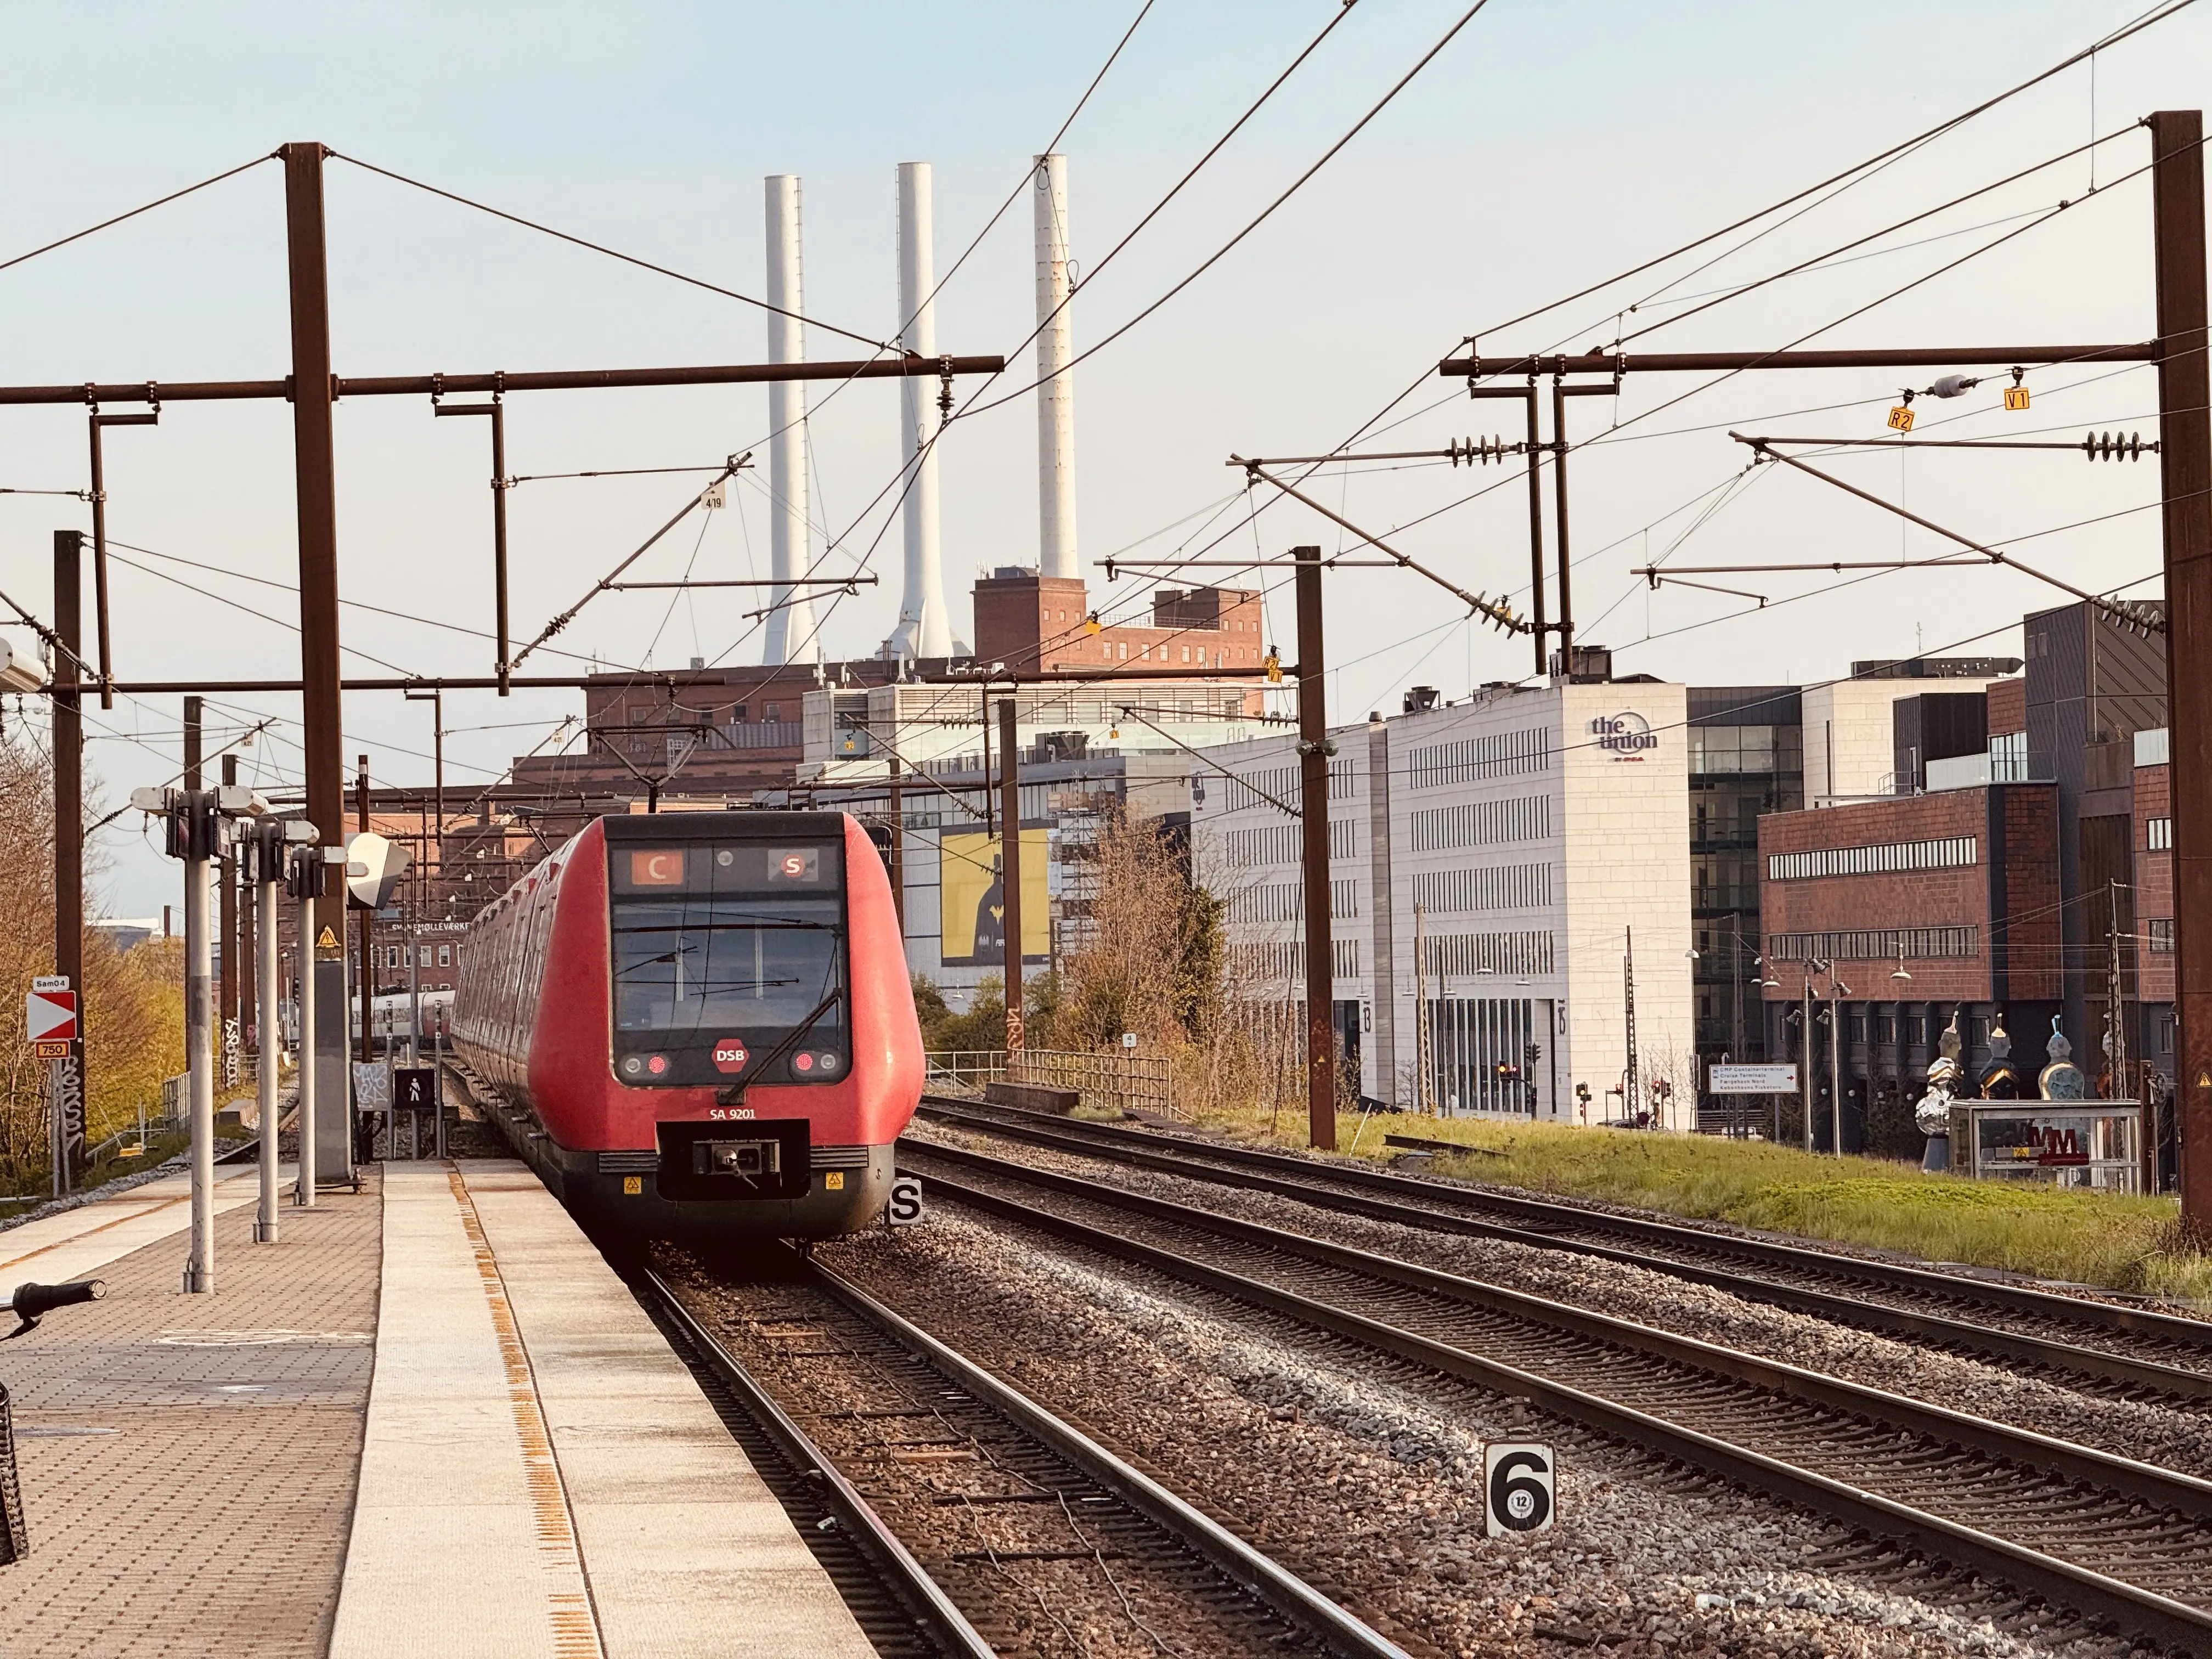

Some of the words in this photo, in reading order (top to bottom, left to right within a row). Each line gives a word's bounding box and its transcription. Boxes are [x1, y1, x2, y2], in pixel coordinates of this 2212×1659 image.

[1891, 411, 1910, 429] R2
[706, 498, 721, 508] 4/19
[1592, 716, 1625, 734] the
[1600, 730, 1658, 749] union
[648, 856, 667, 879] C
[786, 858, 800, 873] S
[42, 1045, 63, 1054] 750
[716, 1050, 744, 1062] DSB
[710, 1109, 726, 1120] SA
[729, 1109, 756, 1120] 9201
[891, 1184, 920, 1221] S
[1490, 1451, 1550, 1532] 6
[1515, 1496, 1527, 1508] 12
